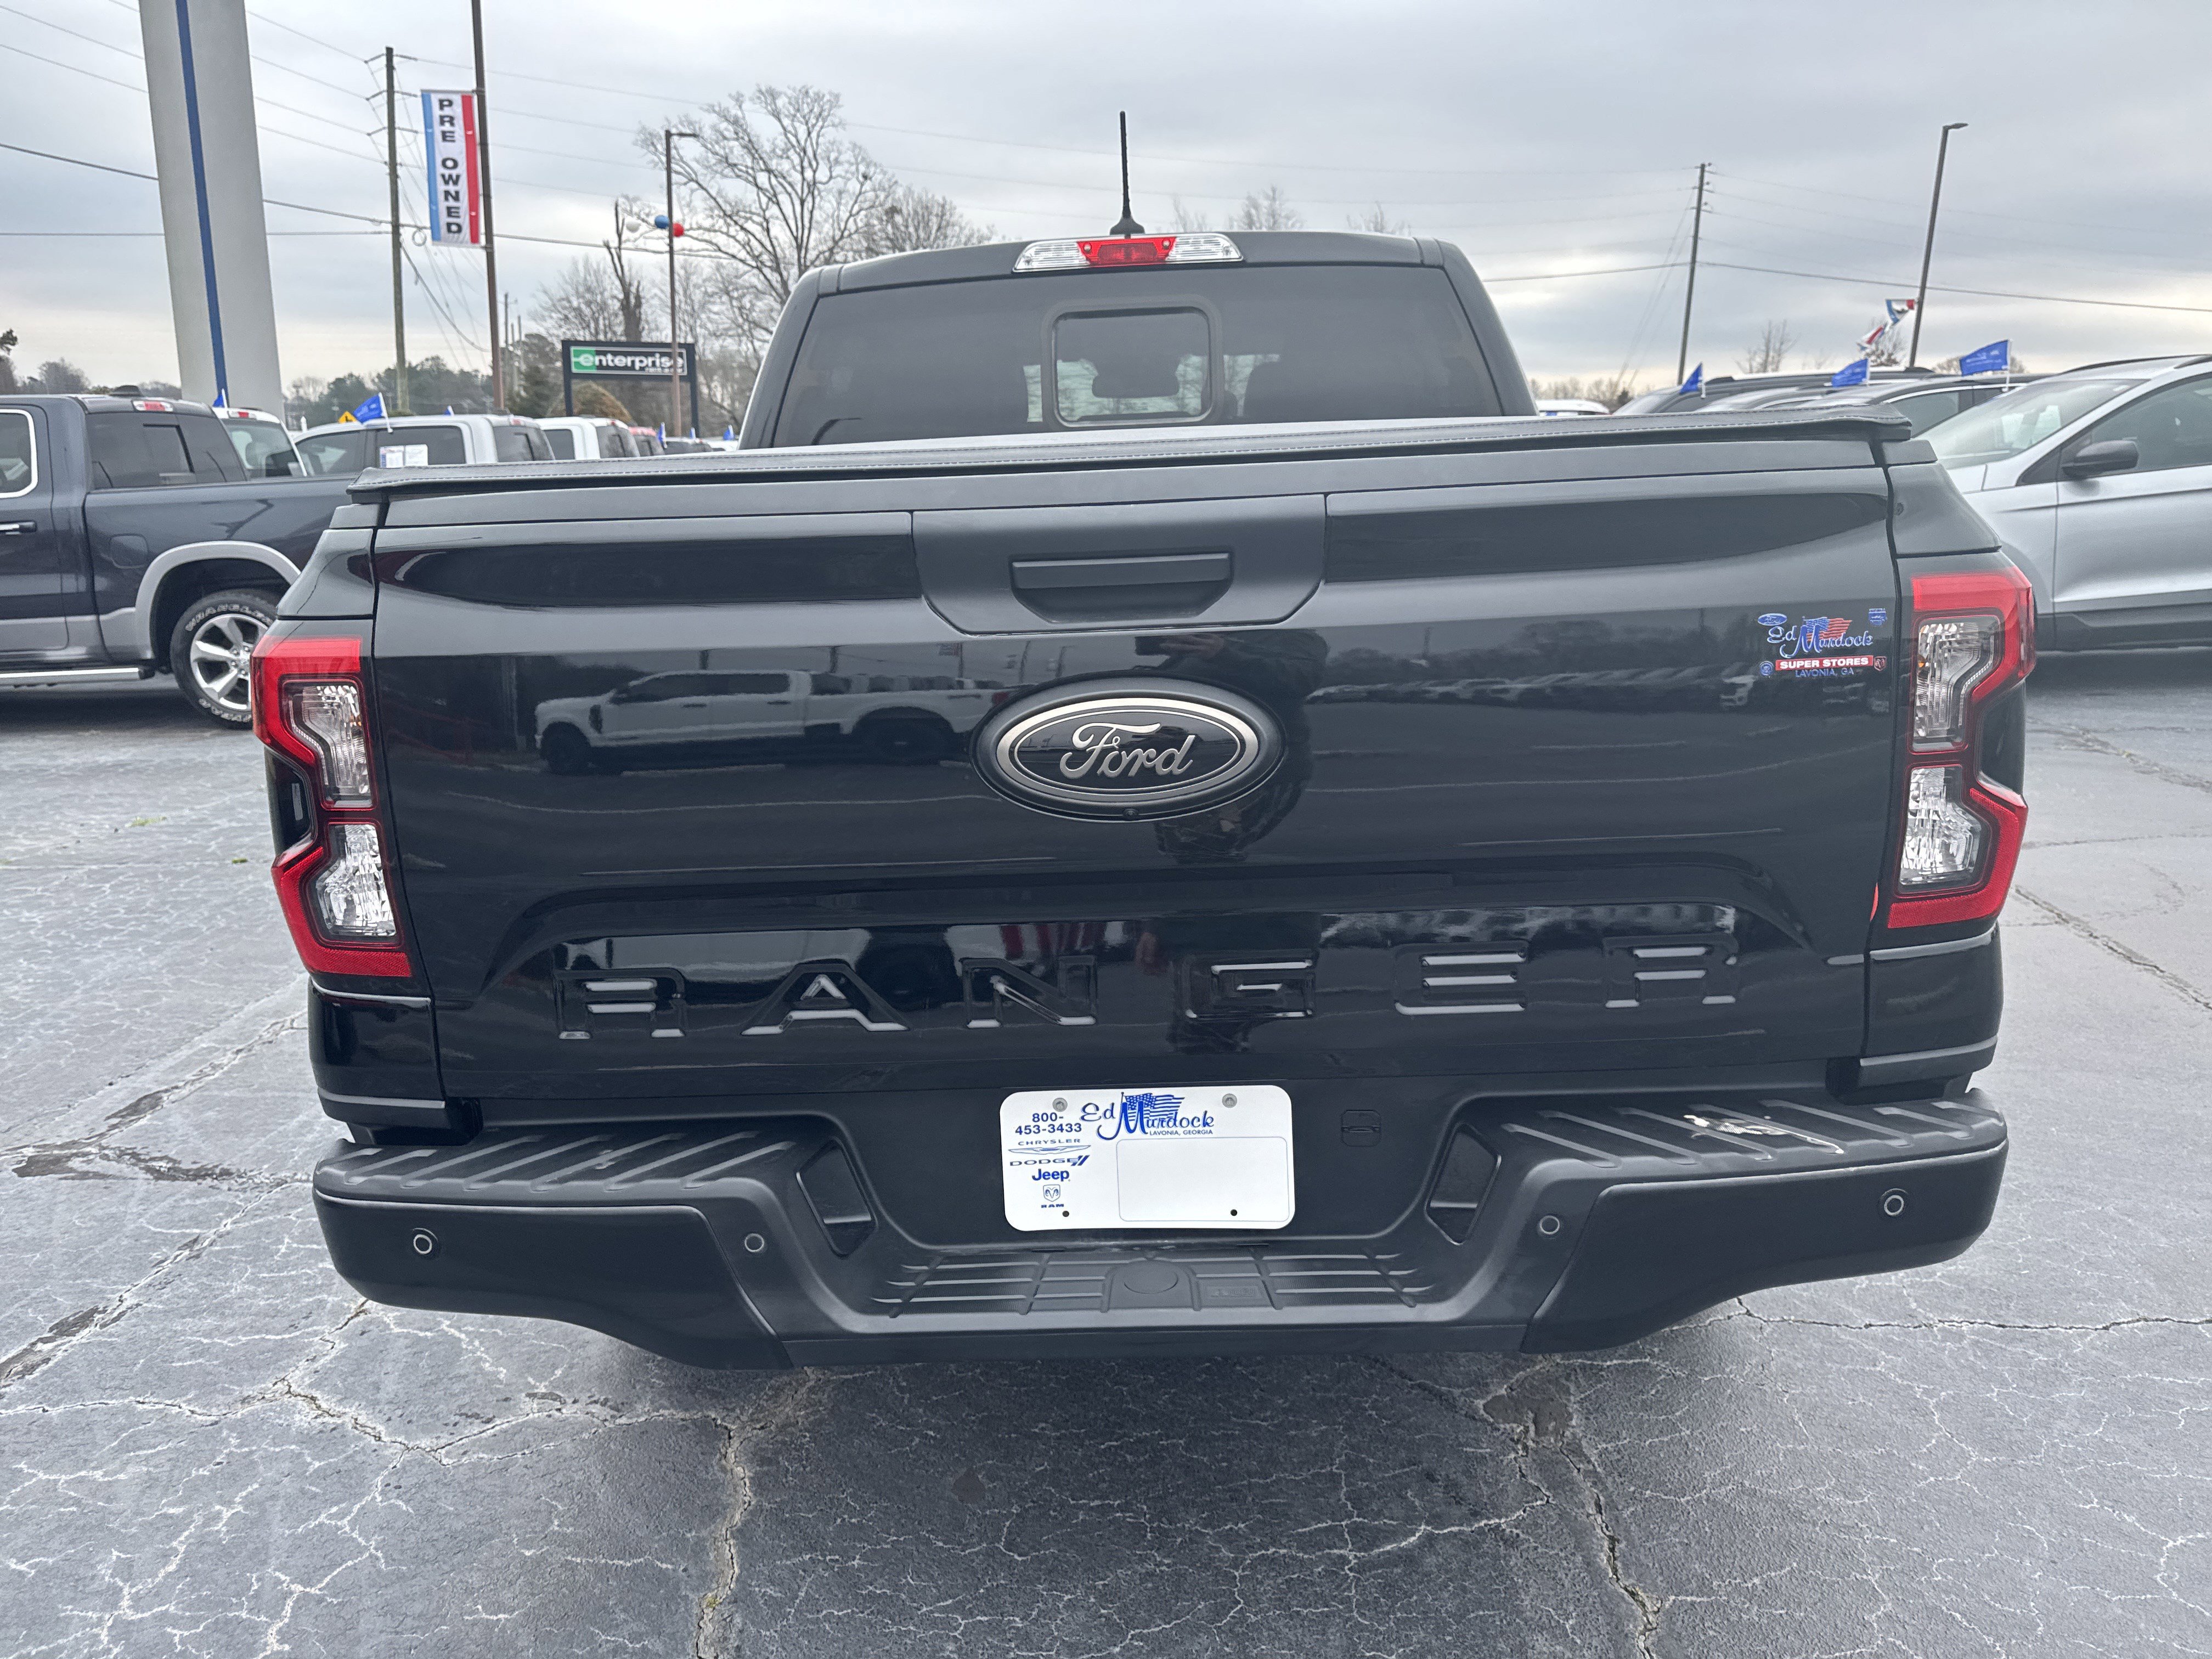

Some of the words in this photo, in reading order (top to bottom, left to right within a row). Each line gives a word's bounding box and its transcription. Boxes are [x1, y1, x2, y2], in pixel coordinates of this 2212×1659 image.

[438, 99, 456, 143] PRE
[441, 157, 462, 234] OWNED
[577, 353, 684, 370] enterprise
[1767, 625, 1798, 644] Ed
[1780, 624, 1874, 658] Murdock
[1780, 660, 1820, 669] SUPER
[1822, 657, 1869, 667] STORES
[1795, 668, 1838, 678] LAVONIA,
[1841, 667, 1854, 675] GA
[1060, 723, 1196, 779] Ford
[552, 935, 1738, 1040] RANGER
[1032, 1112, 1064, 1122] 800-
[1079, 1102, 1116, 1121] Ed
[1096, 1100, 1215, 1141] Murdock
[1015, 1123, 1082, 1135] 453-3433
[1009, 1158, 1080, 1166] DODGE
[1031, 1169, 1070, 1182] Jeep
